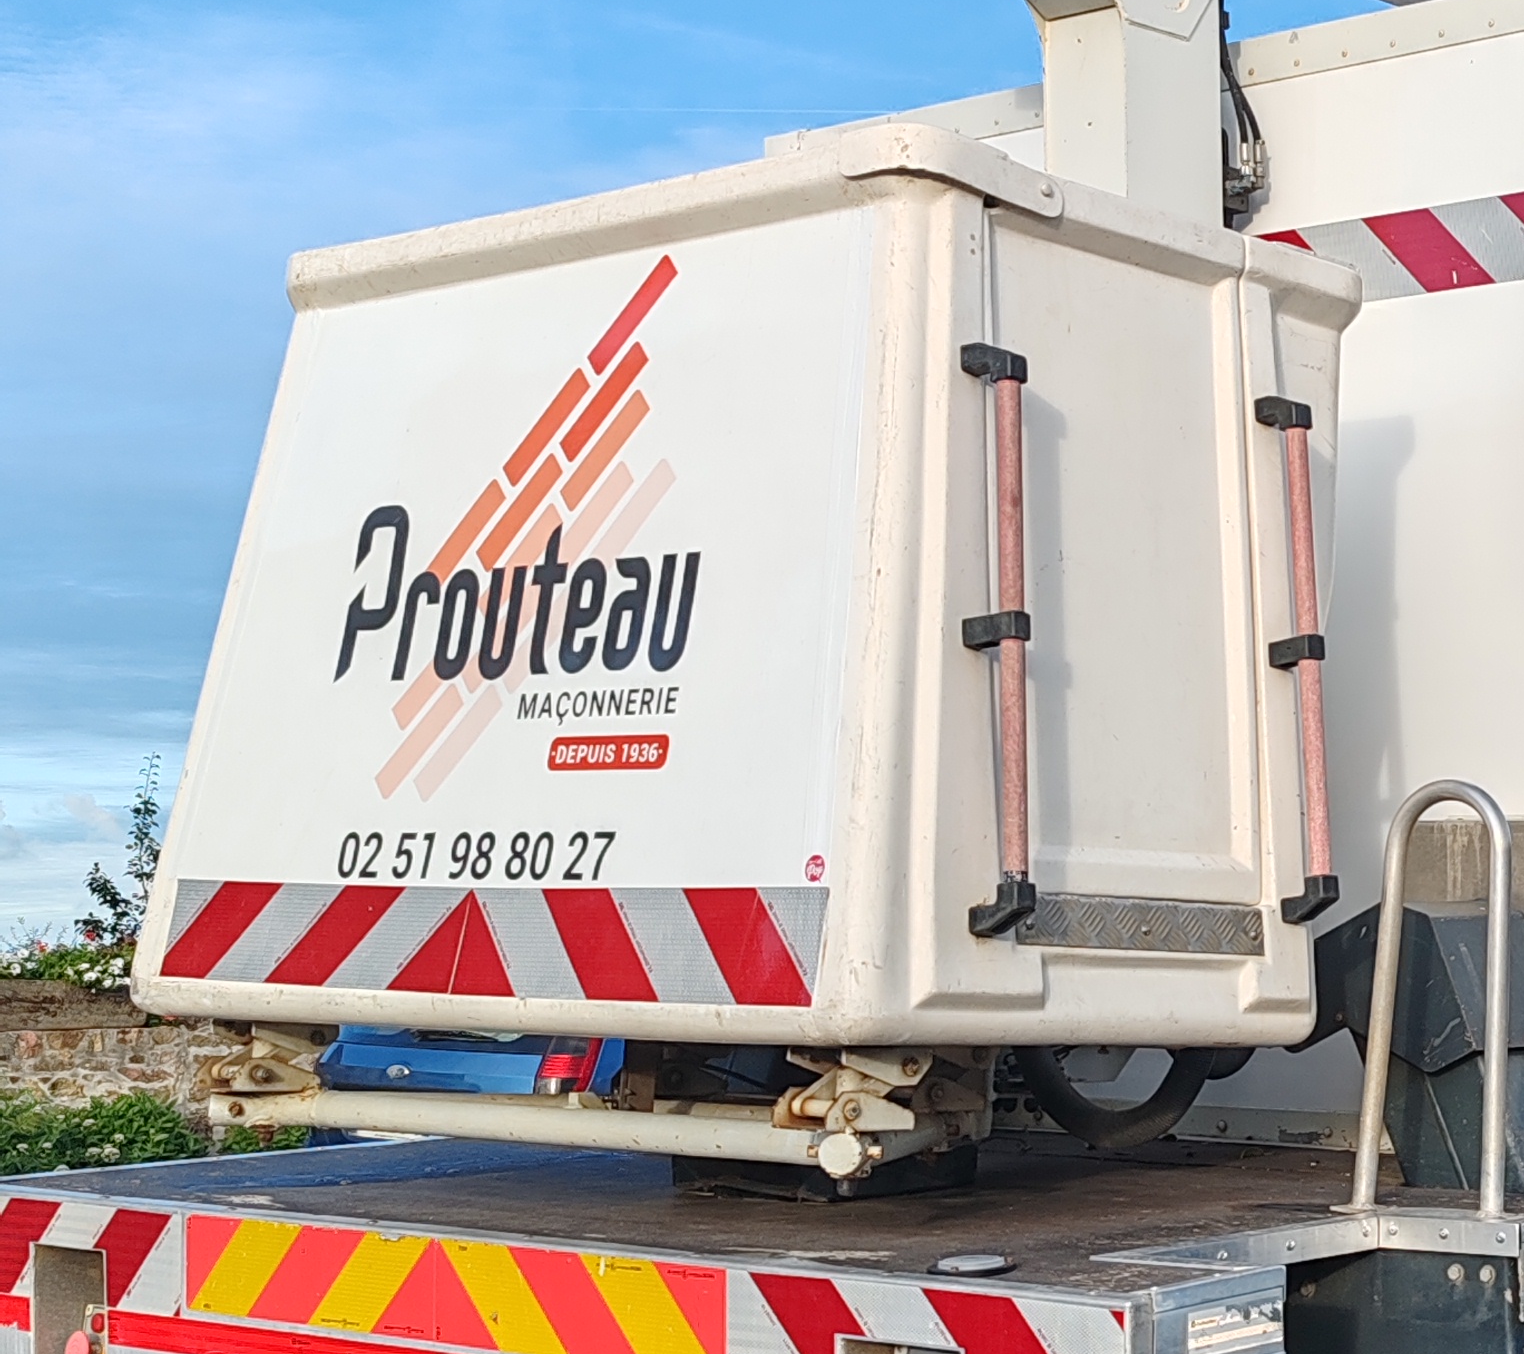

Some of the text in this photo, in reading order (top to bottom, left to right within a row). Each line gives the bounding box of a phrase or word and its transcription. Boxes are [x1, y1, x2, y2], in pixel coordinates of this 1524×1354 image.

[333, 505, 701, 683] Prouteau
[517, 686, 679, 726] MAÇONNERIE
[555, 742, 660, 765] DEPUIS 1936
[337, 830, 617, 881] 02 51 98 80 27
